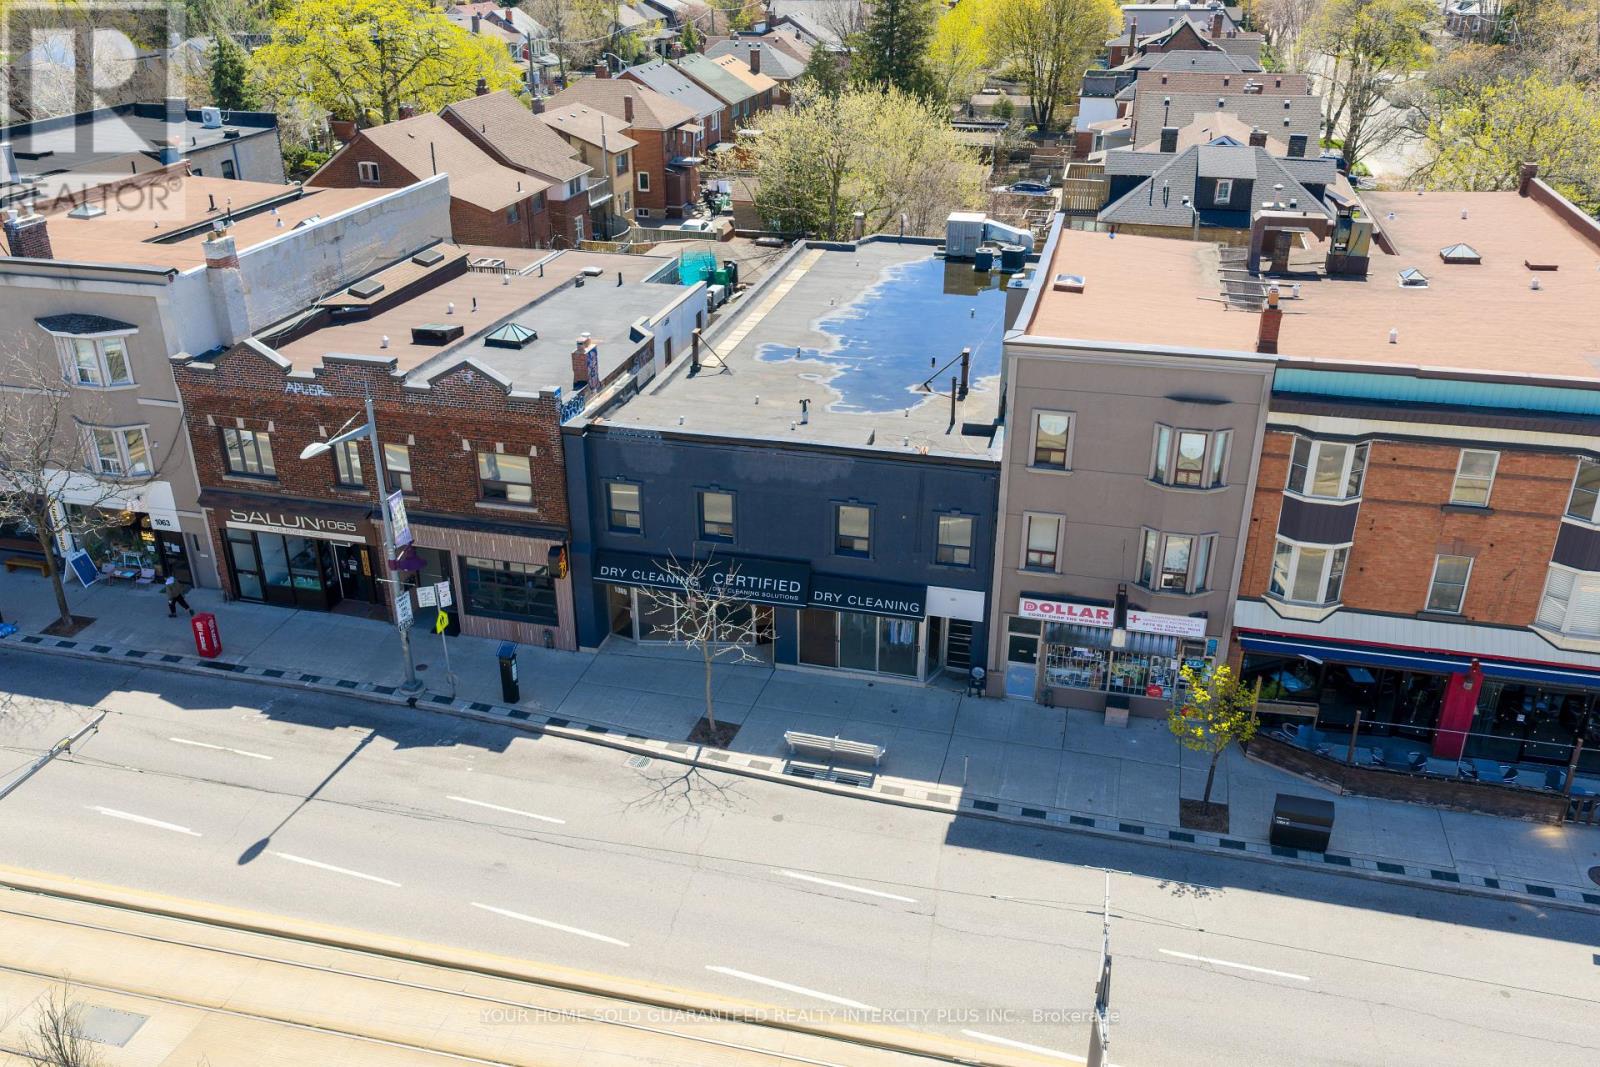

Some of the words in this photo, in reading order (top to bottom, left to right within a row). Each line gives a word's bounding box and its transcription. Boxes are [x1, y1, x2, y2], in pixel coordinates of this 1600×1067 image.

[154, 518, 171, 527] 1063
[320, 519, 357, 532] 1065
[600, 566, 627, 578] DRY
[631, 570, 700, 587] CLEANING
[712, 572, 801, 593] CERTIFIED
[727, 588, 760, 597] CLEANING
[761, 593, 799, 601] SOLUTIONS
[813, 590, 842, 603] DRY
[847, 595, 920, 613] CLEANING
[1023, 600, 1110, 620] DOLLAR
